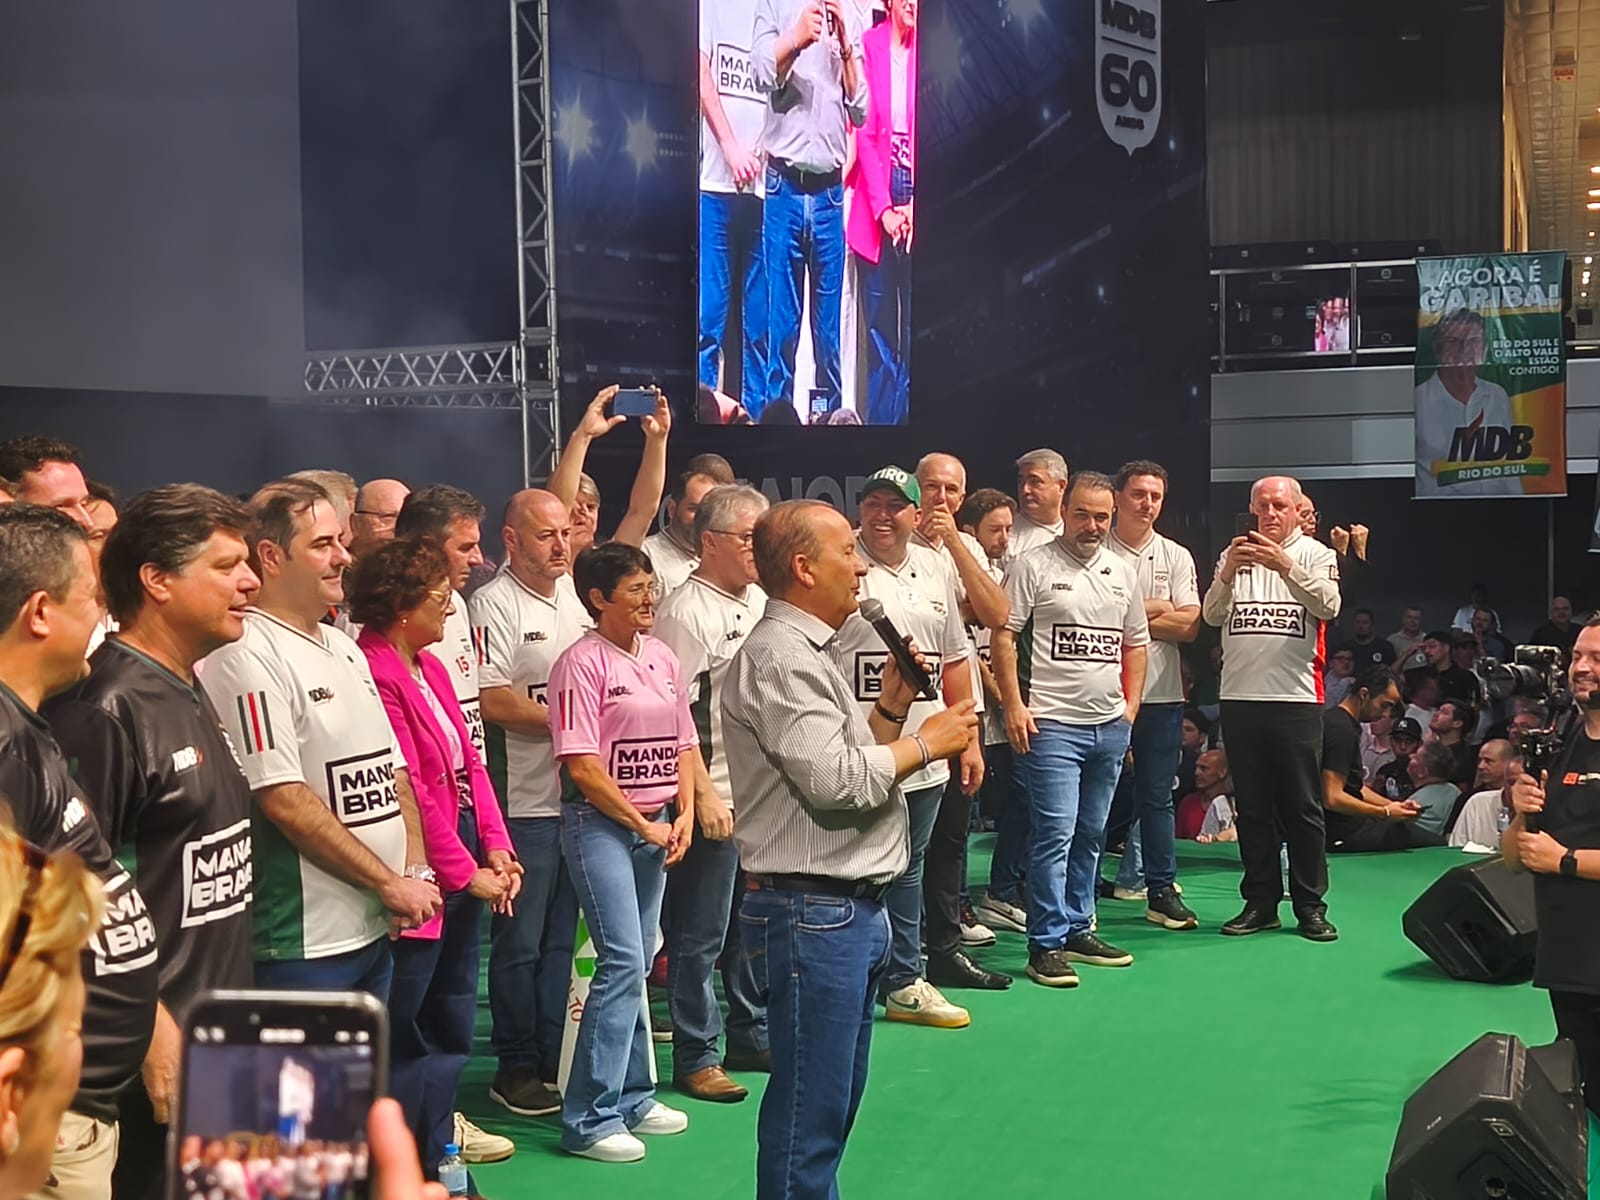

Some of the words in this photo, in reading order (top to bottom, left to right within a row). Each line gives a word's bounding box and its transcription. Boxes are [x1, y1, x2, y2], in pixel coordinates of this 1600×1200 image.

[1101, 53, 1157, 112] 60
[1439, 265, 1524, 288] AGORA
[1529, 259, 1541, 283] É
[1420, 283, 1559, 313] GARIBA!
[1493, 340, 1512, 348] RIO
[1532, 339, 1552, 347] SUL
[1494, 349, 1503, 358] O
[1505, 348, 1531, 357] ALTO
[1533, 347, 1559, 356] VALE
[1509, 365, 1559, 375] CONTIGO!
[1447, 425, 1534, 462] MDB
[1458, 470, 1481, 479] RIO
[1483, 467, 1501, 477] DO
[1504, 465, 1527, 475] SUL
[1236, 608, 1300, 620] MANDA
[1233, 618, 1300, 632] BRASA
